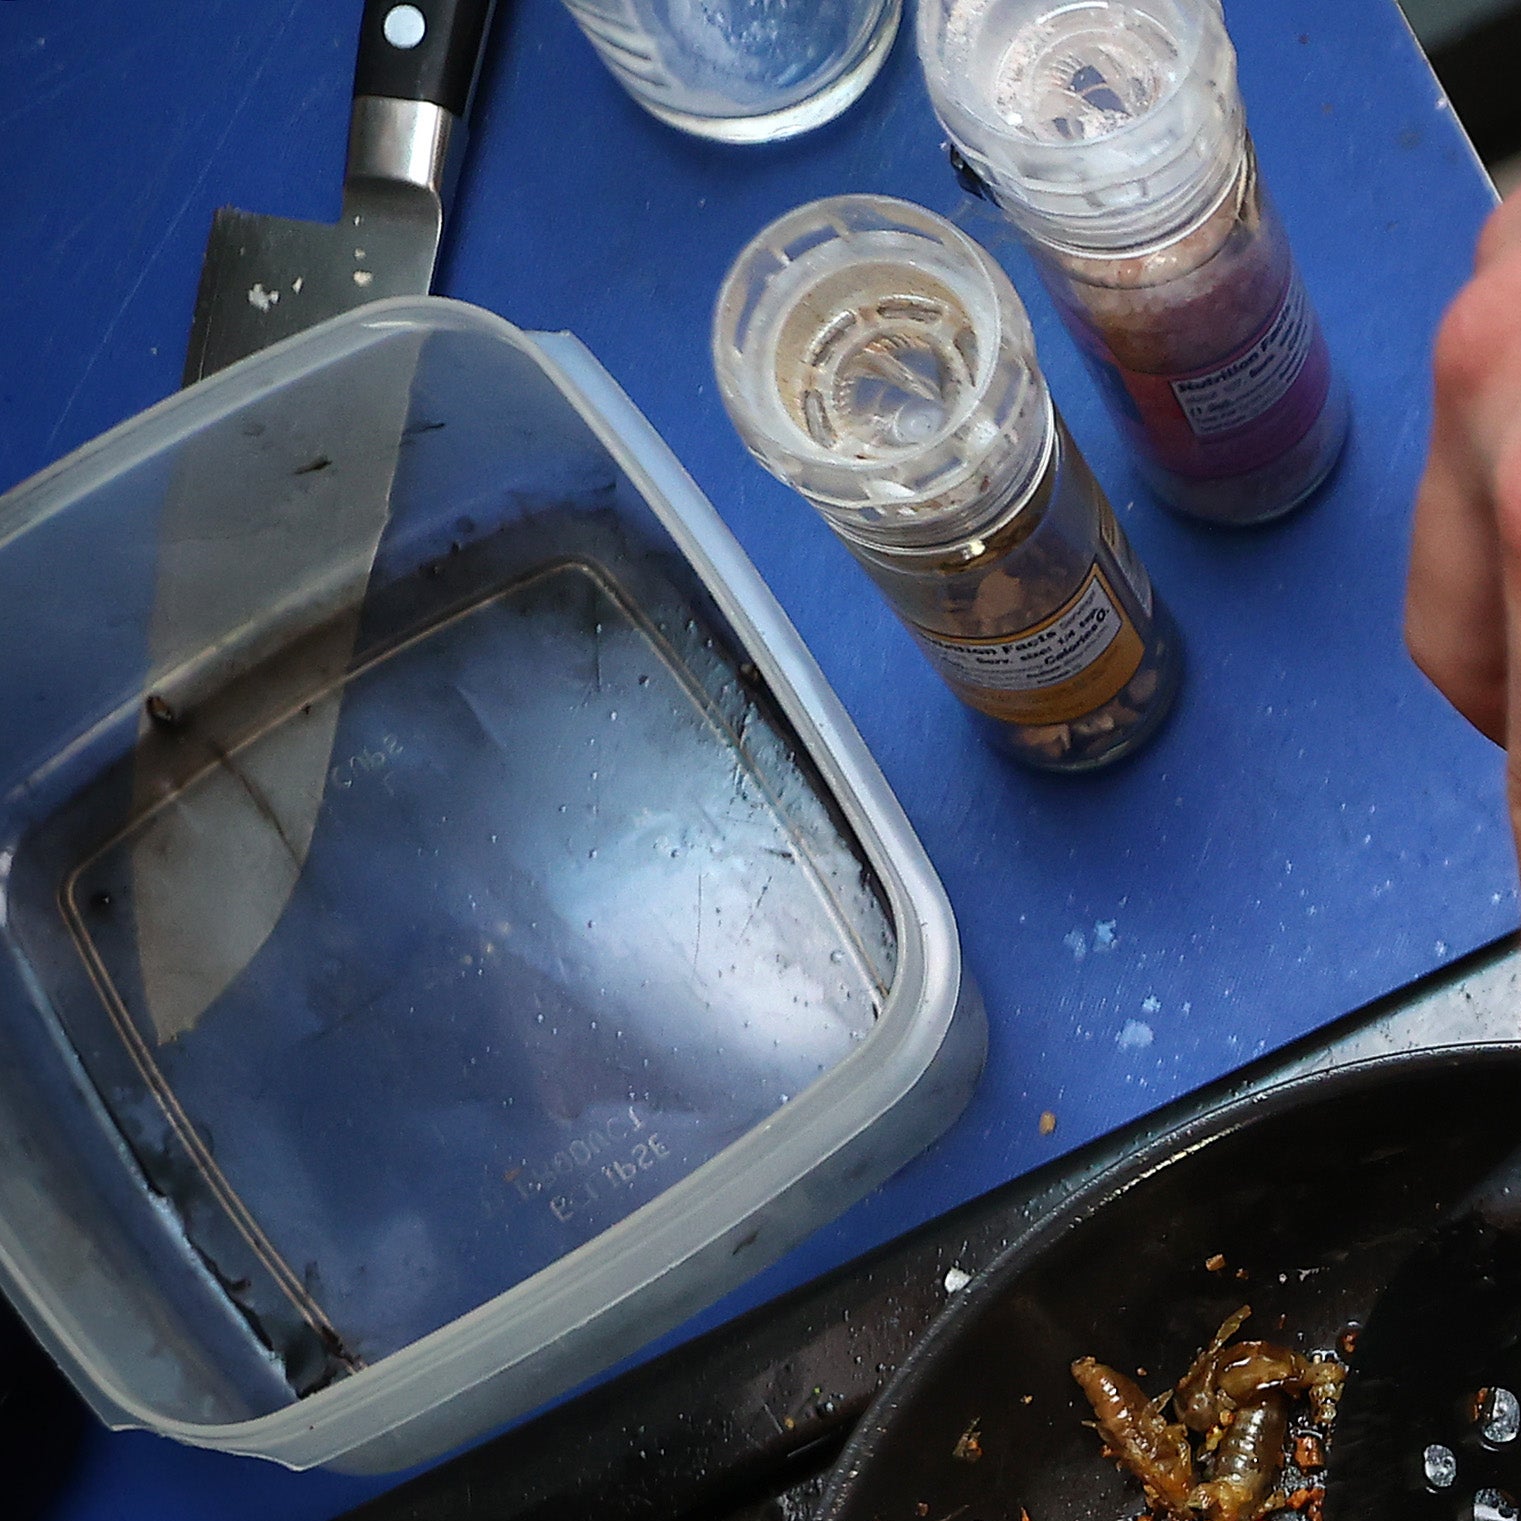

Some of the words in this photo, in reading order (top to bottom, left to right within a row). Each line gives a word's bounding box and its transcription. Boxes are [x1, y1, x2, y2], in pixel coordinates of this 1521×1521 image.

[1177, 351, 1259, 393] Nutrition
[1001, 631, 1056, 655] Facts
[1044, 624, 1098, 665] Calories
